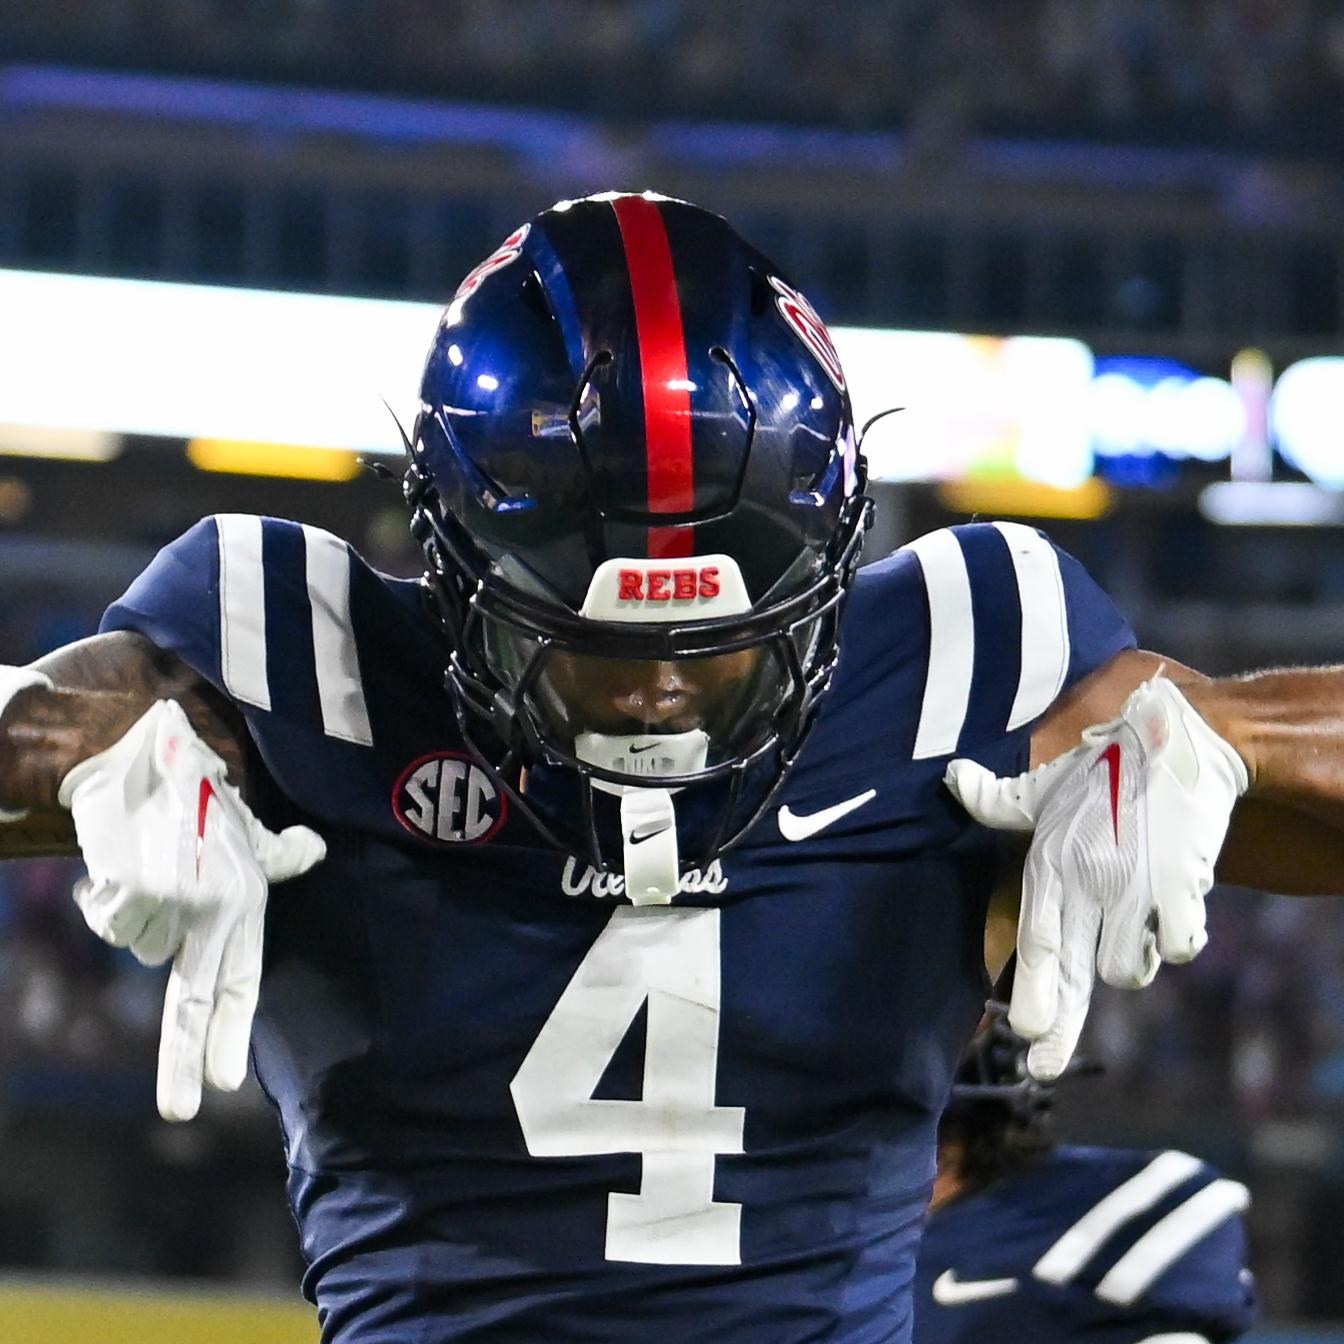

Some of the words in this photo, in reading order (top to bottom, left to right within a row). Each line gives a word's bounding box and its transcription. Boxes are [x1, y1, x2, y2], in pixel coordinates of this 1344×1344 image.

[618, 566, 721, 603] REBS
[404, 759, 497, 842] SEC
[508, 904, 747, 1266] 4
